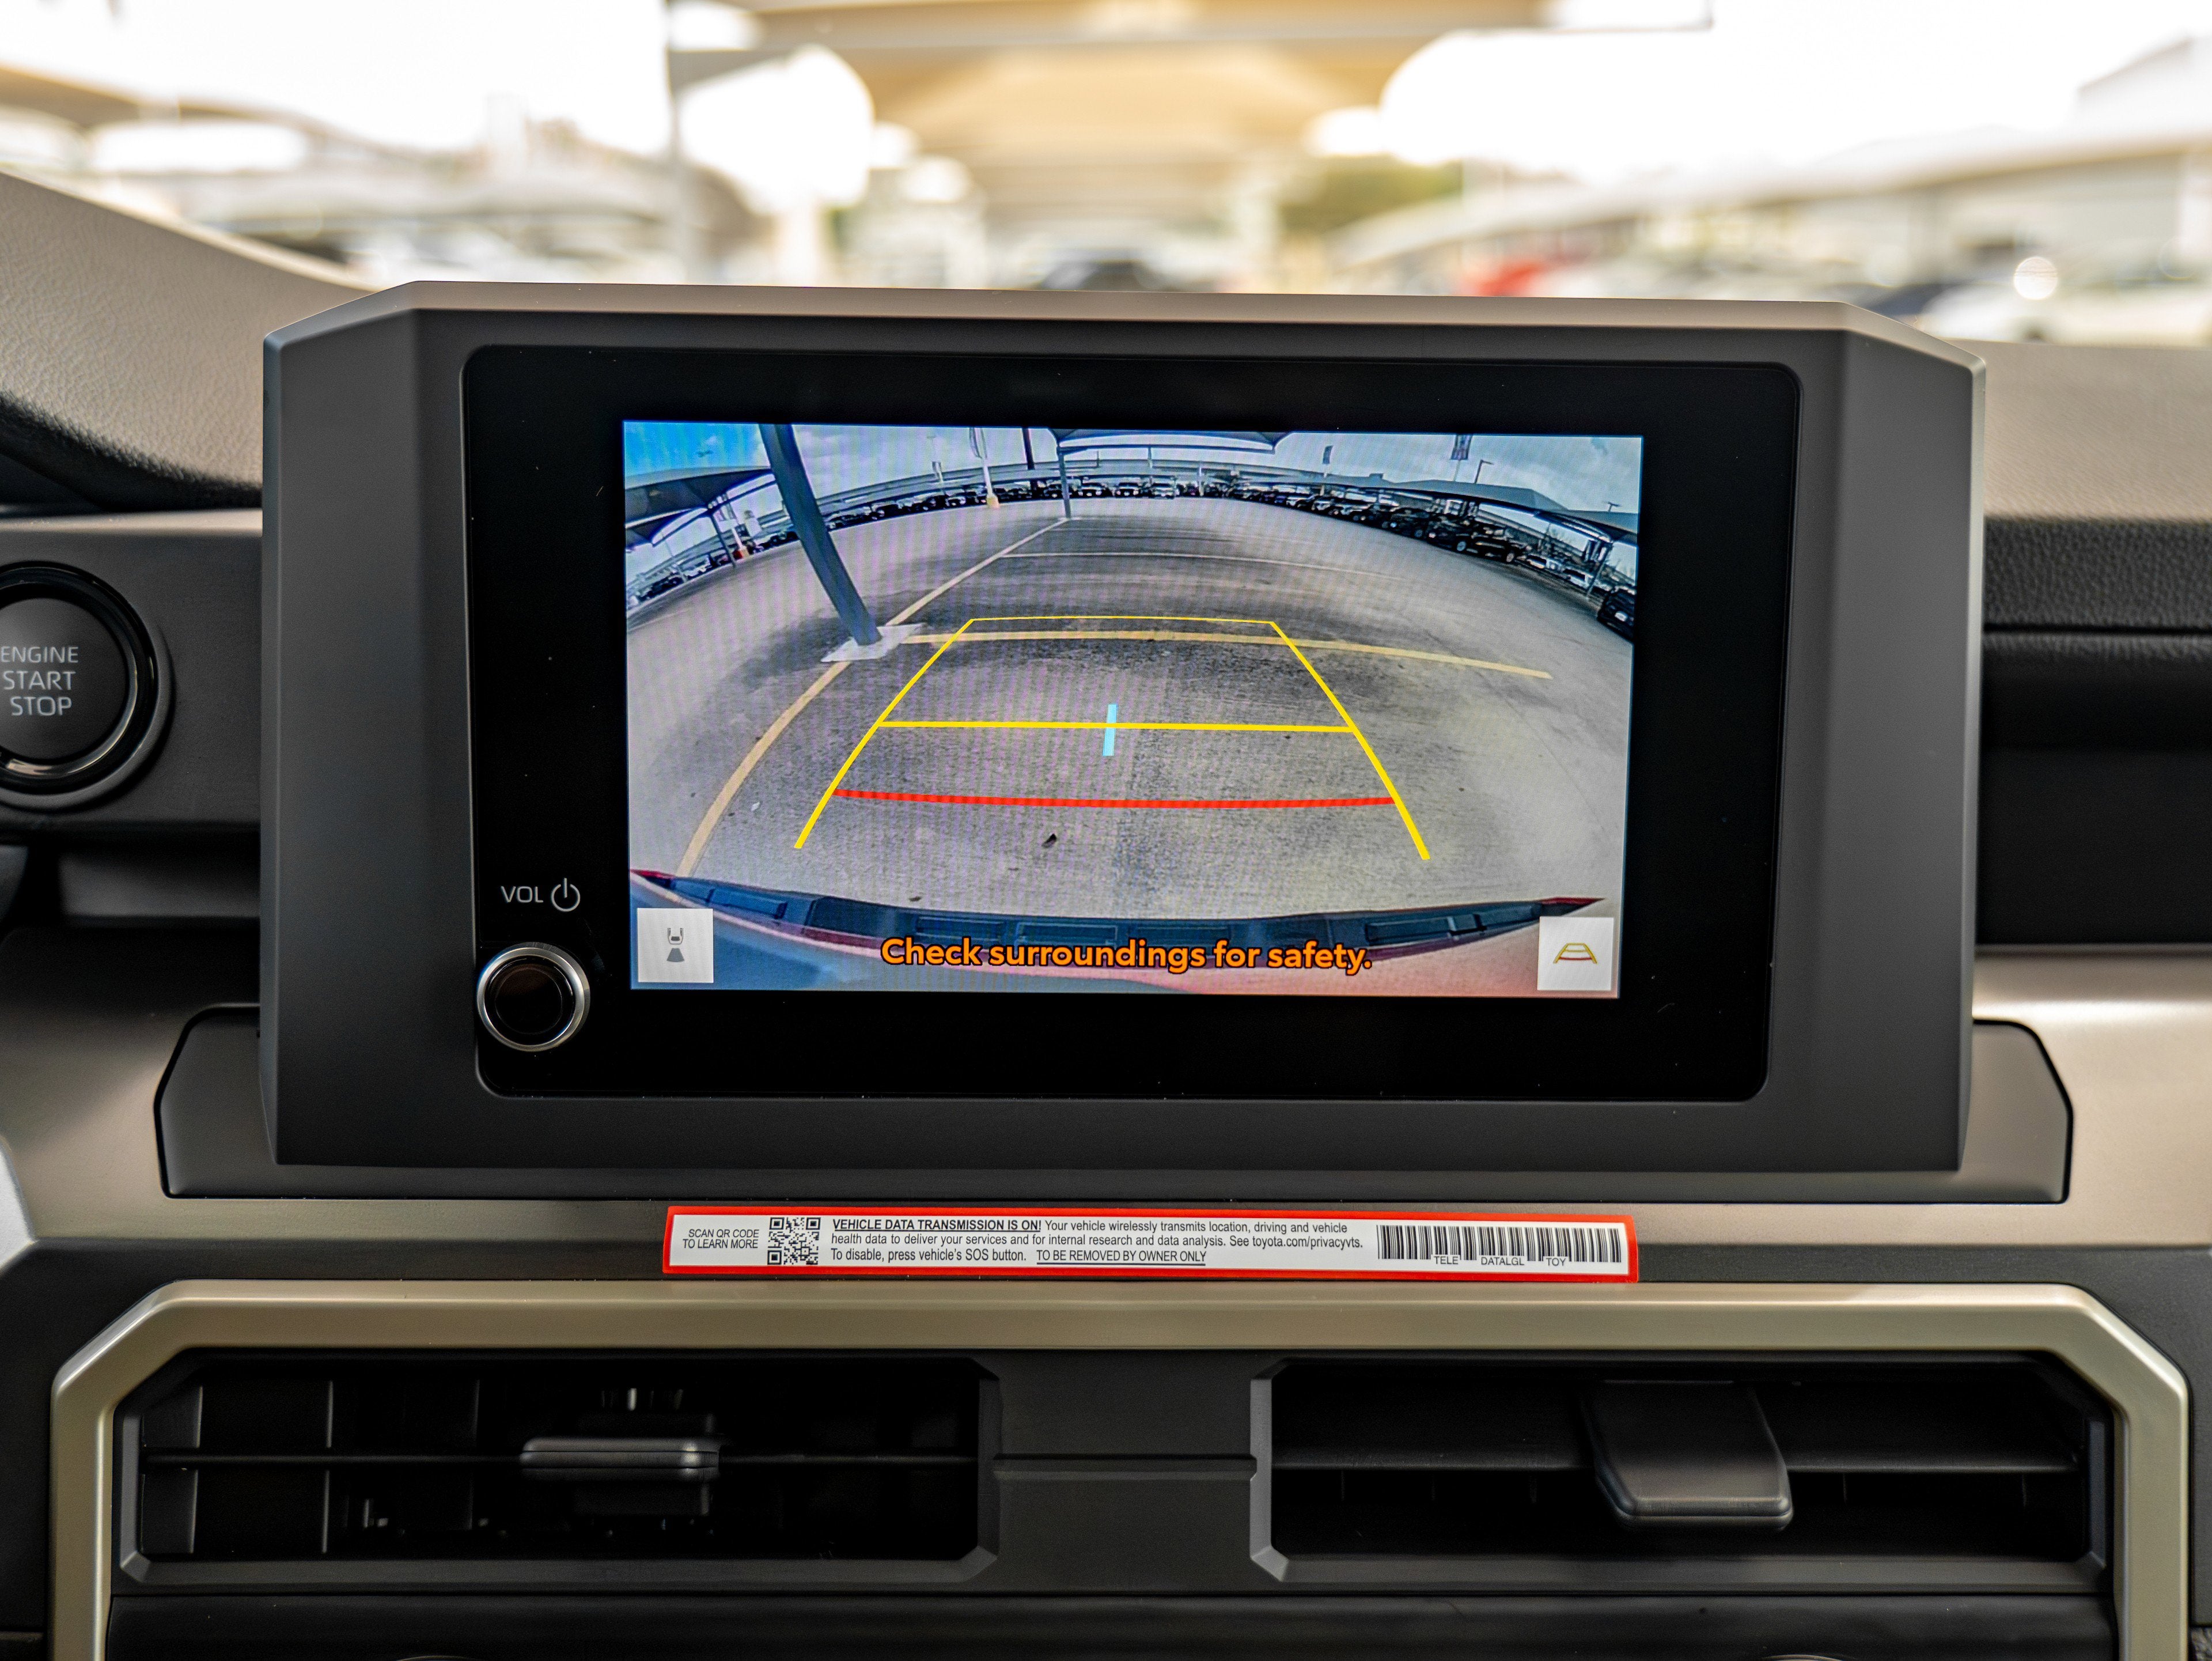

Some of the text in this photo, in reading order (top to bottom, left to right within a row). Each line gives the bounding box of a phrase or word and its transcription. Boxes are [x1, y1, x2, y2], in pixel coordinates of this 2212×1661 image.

[1, 646, 78, 663] ENGINE
[3, 671, 76, 690] START
[10, 696, 72, 716] STOP
[501, 886, 543, 903] VOL
[881, 936, 1373, 976] Check surroundings for safety.
[689, 1229, 759, 1239] SCAN QR CODE
[833, 1219, 1347, 1234] VEHICLE DATA TRANSMISSION IS ON! Your vehicle wirelessly transmits location, driving and vehicle
[683, 1239, 757, 1248] TO LEARN MORE
[832, 1234, 1362, 1250] health data to deliver your services and for internal research and data analysis. See toyota.com/privacyvts.
[831, 1248, 1206, 1262] To disable, press vehicle’s SOS button. TO BE REMOVED BY OWNER ONLY
[1434, 1257, 1566, 1266] TELE DATALGL TOY
